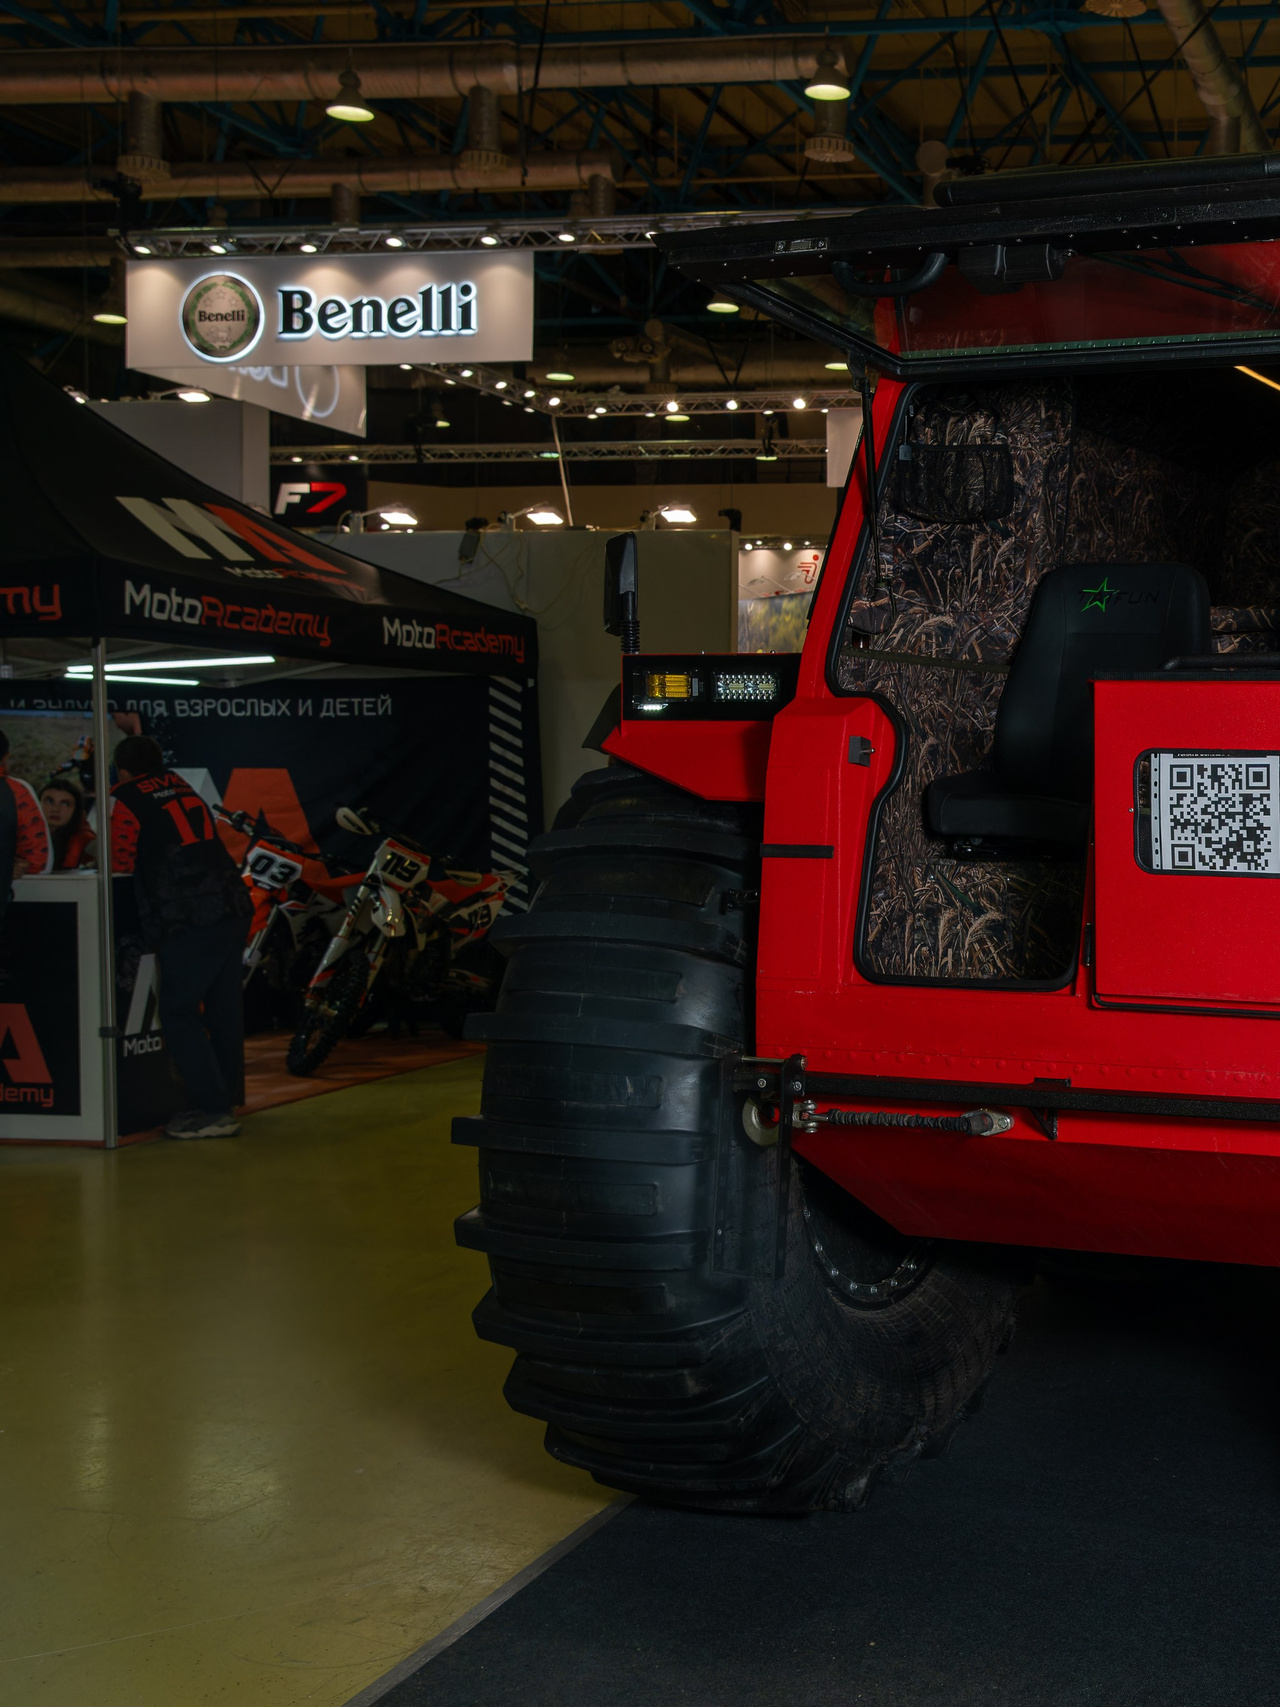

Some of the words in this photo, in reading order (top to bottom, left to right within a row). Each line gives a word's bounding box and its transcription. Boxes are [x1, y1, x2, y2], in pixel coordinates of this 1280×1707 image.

[198, 309, 246, 322] Benelli
[277, 282, 477, 337] Benelli
[274, 482, 348, 515] F7
[124, 579, 333, 648] MotoAcademy
[382, 616, 526, 664] MotoAcademy
[175, 698, 291, 718] ВЗРОСЛЫХ
[298, 698, 312, 717] И
[319, 694, 393, 719] ДЕТЕЙ
[161, 796, 214, 847] 17
[250, 854, 297, 884] 03
